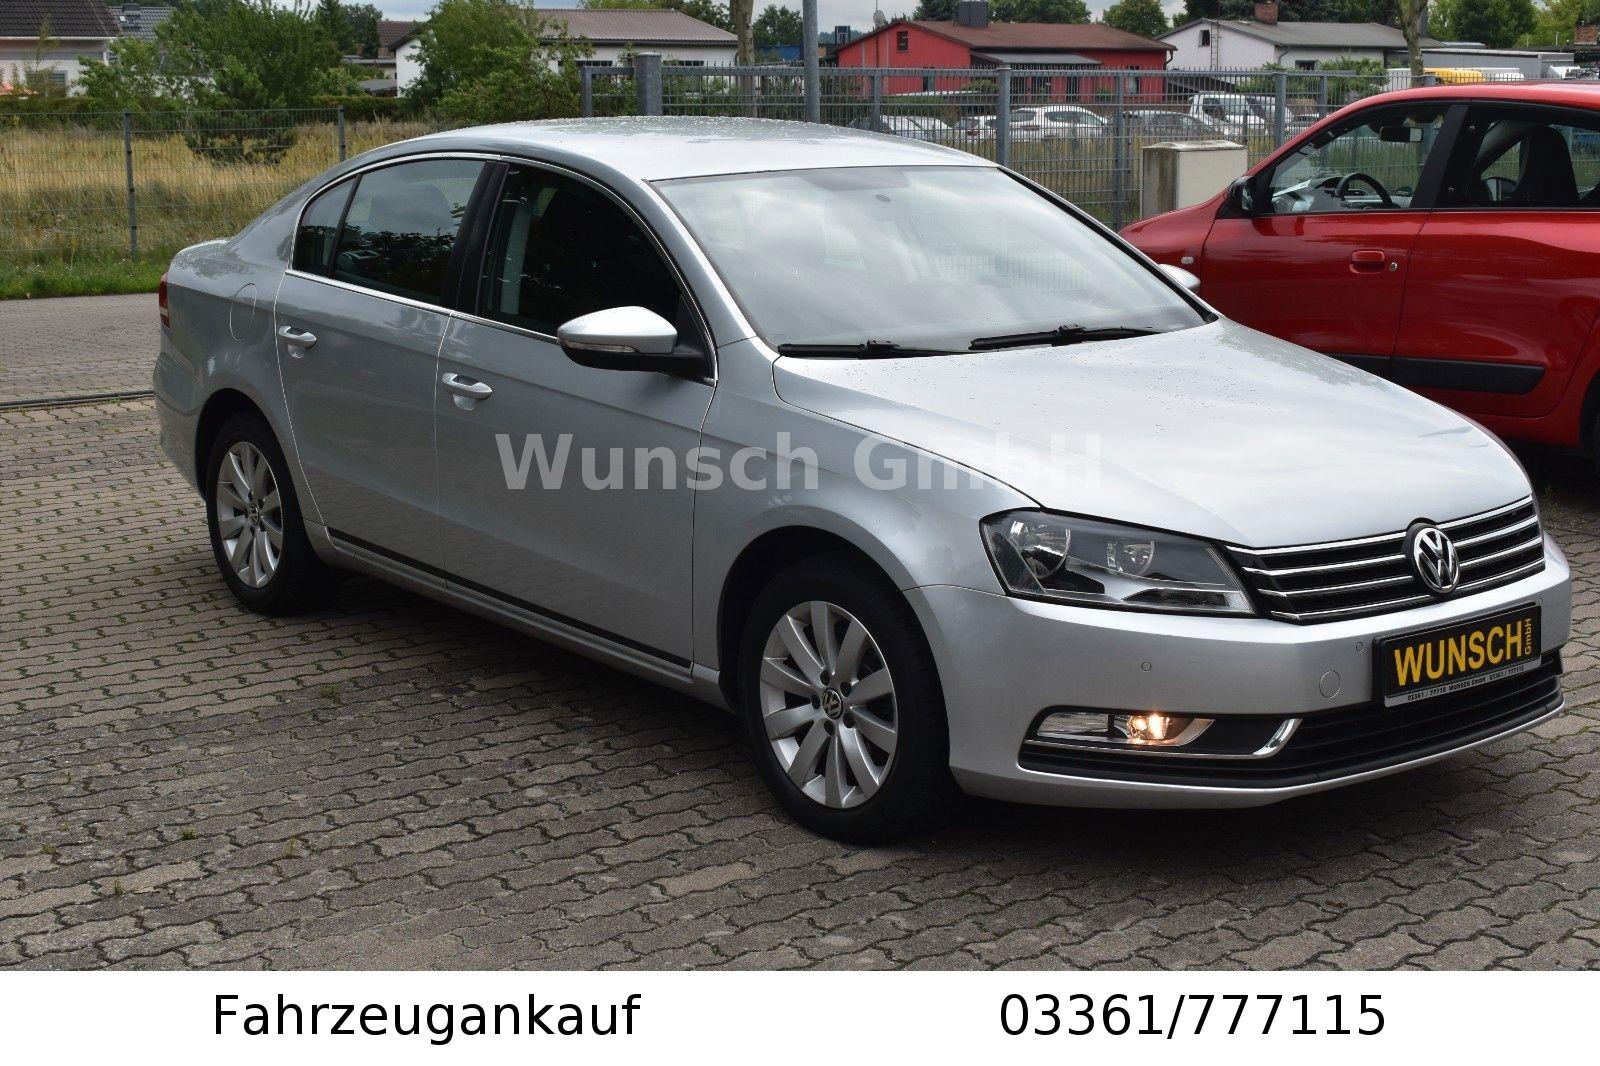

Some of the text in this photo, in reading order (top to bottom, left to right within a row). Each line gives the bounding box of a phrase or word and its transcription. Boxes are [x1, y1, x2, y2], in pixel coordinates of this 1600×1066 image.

[1414, 527, 1459, 593] VW
[1394, 620, 1522, 687] WUNSCH
[1524, 617, 1532, 655] GmbH
